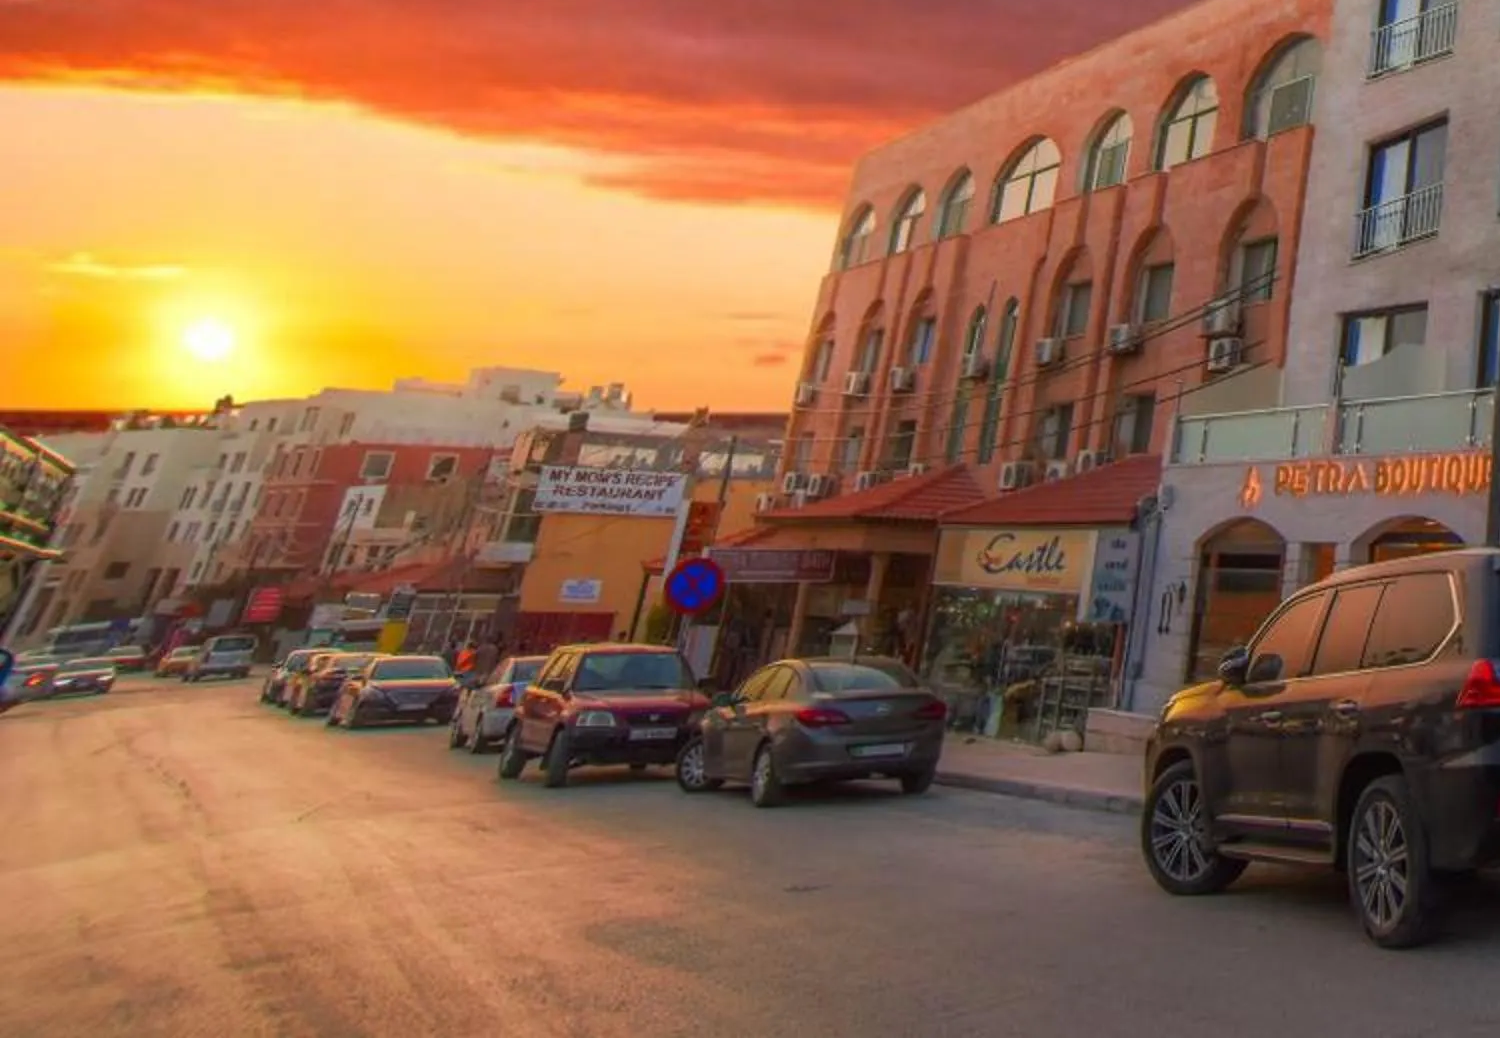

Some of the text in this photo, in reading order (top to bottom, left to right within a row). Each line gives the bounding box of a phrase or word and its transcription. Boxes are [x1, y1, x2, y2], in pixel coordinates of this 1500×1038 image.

[549, 469, 571, 482] MY
[1275, 463, 1368, 497] PETRA
[552, 484, 666, 500] RESTAURANT
[977, 532, 1065, 575] Castle
